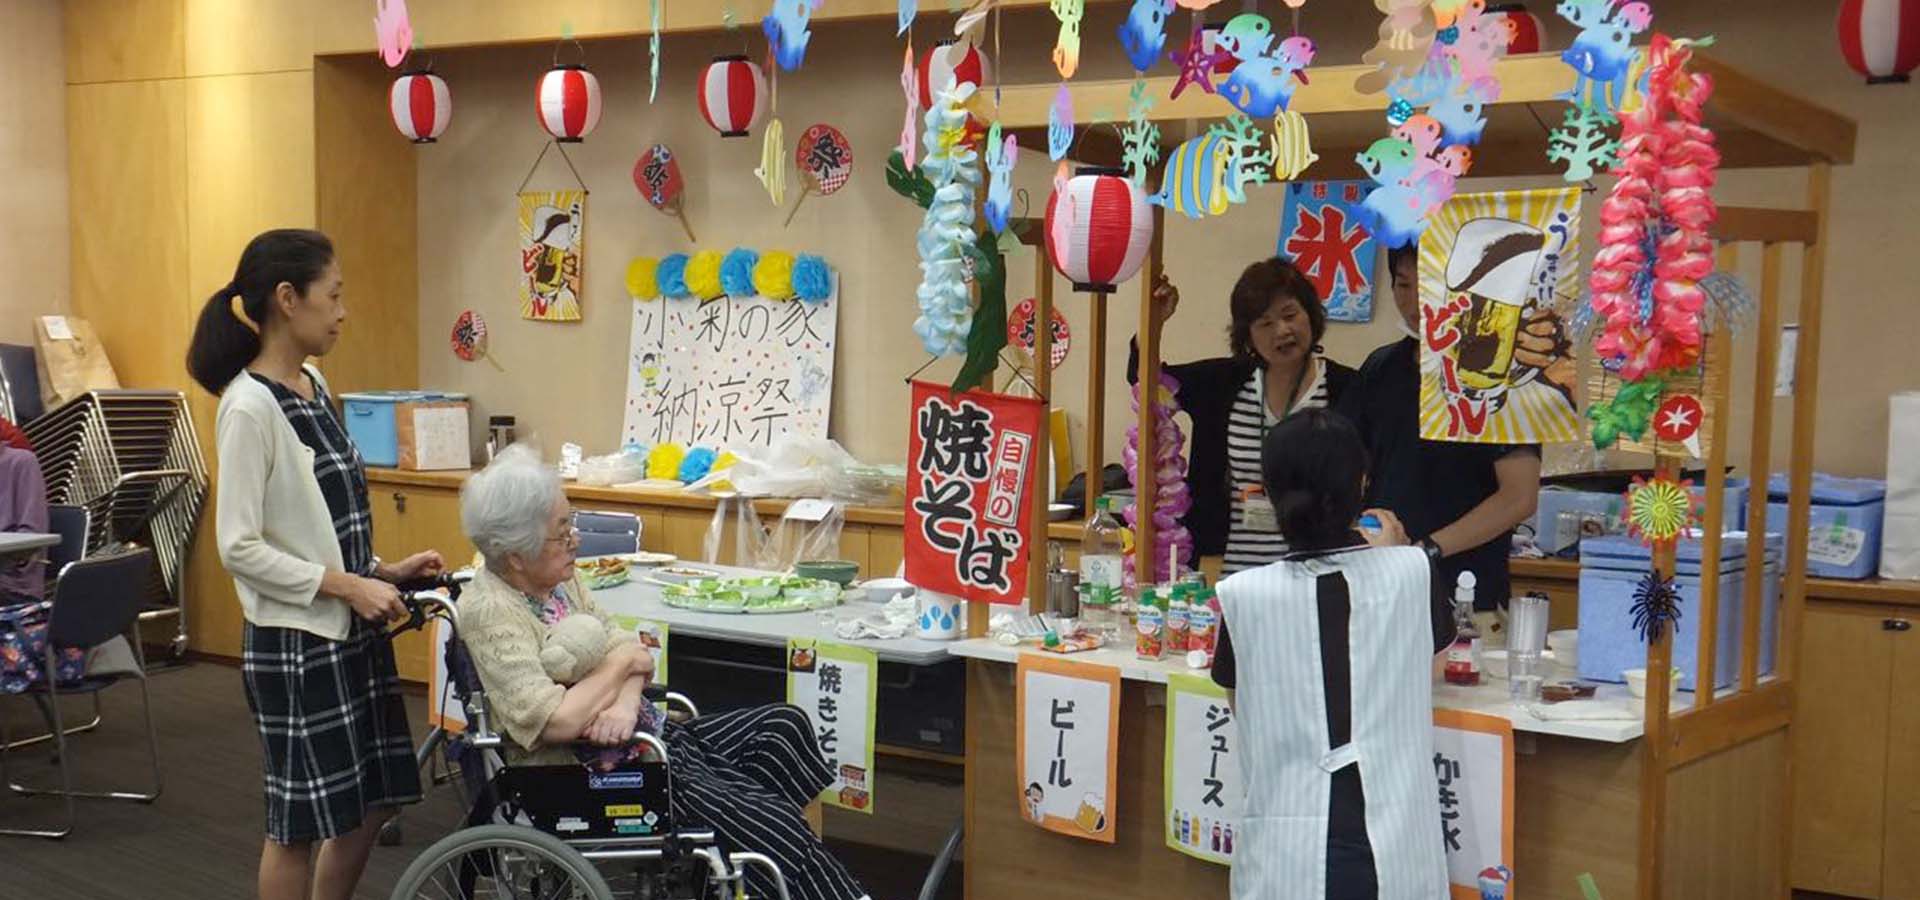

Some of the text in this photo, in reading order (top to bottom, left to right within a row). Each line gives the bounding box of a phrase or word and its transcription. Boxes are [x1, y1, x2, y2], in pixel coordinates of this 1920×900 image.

[808, 132, 844, 179] 祭
[1286, 205, 1372, 302] 氷
[643, 293, 821, 352] 小菊の家
[1423, 296, 1487, 436] ビール
[653, 376, 791, 447] 納涼祭
[914, 399, 1020, 591] 焼そば
[991, 437, 1023, 519] 自慢の
[1048, 699, 1075, 788] ビール
[1202, 705, 1230, 808] ジュース
